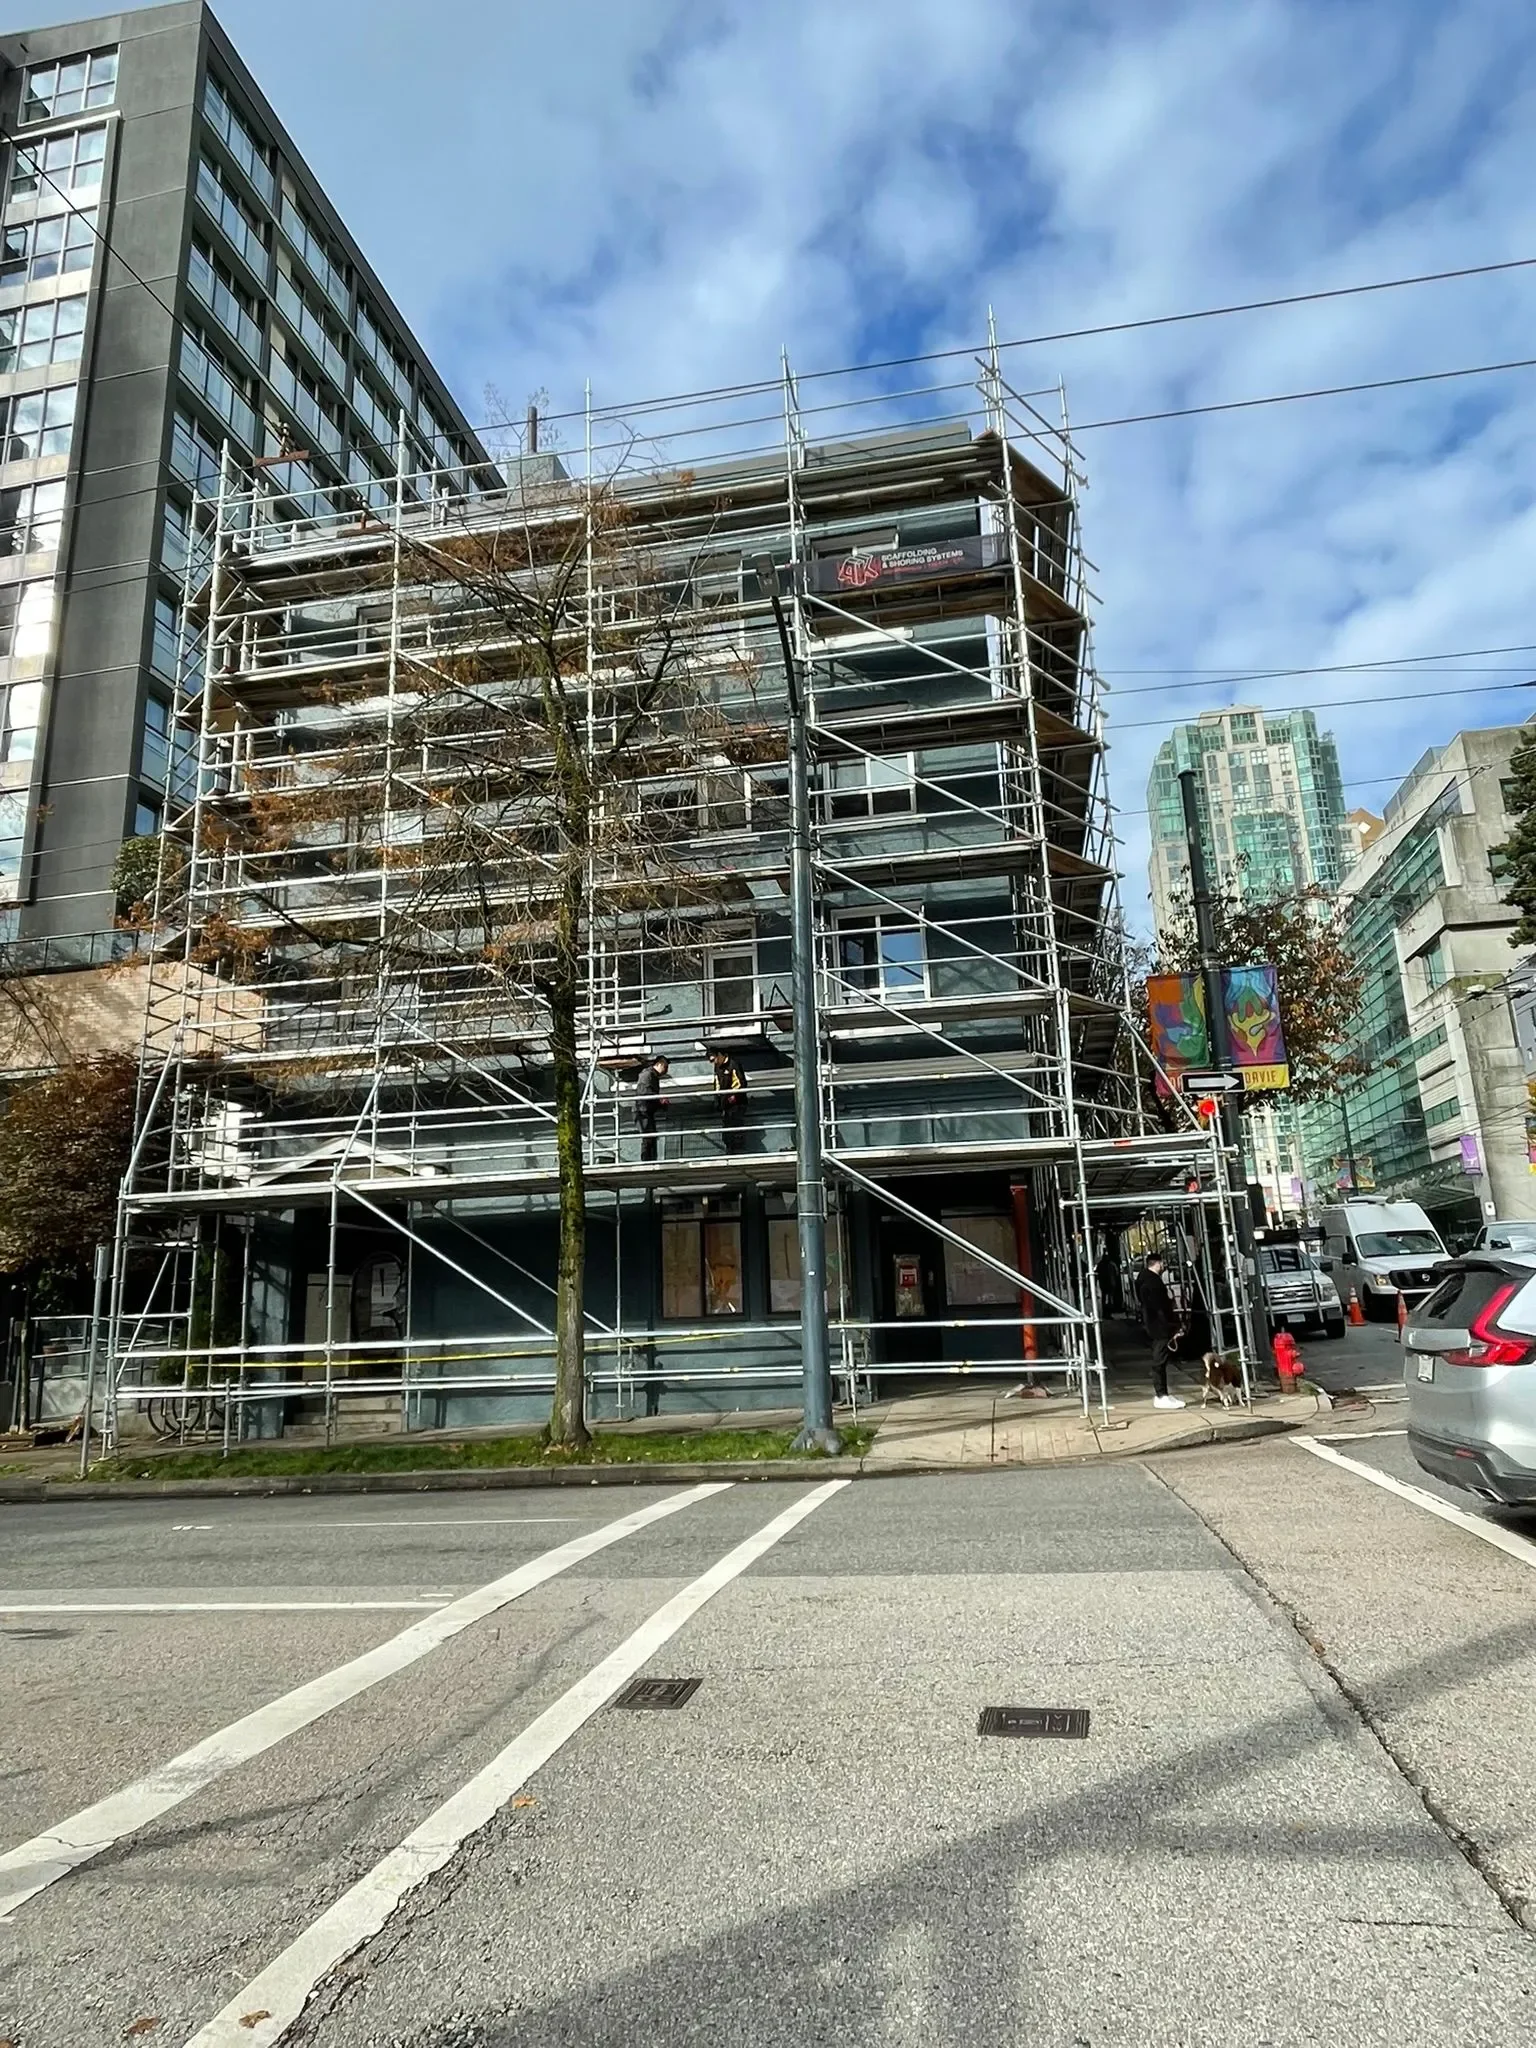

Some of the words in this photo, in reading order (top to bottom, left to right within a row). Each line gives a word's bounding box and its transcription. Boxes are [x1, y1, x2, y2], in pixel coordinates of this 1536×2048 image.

[882, 548, 937, 561] SCAFFOLDING
[882, 561, 889, 569] &
[889, 557, 925, 568] SHORING
[926, 550, 963, 562] SYSTEMS
[1244, 1070, 1276, 1084] DAVIE
